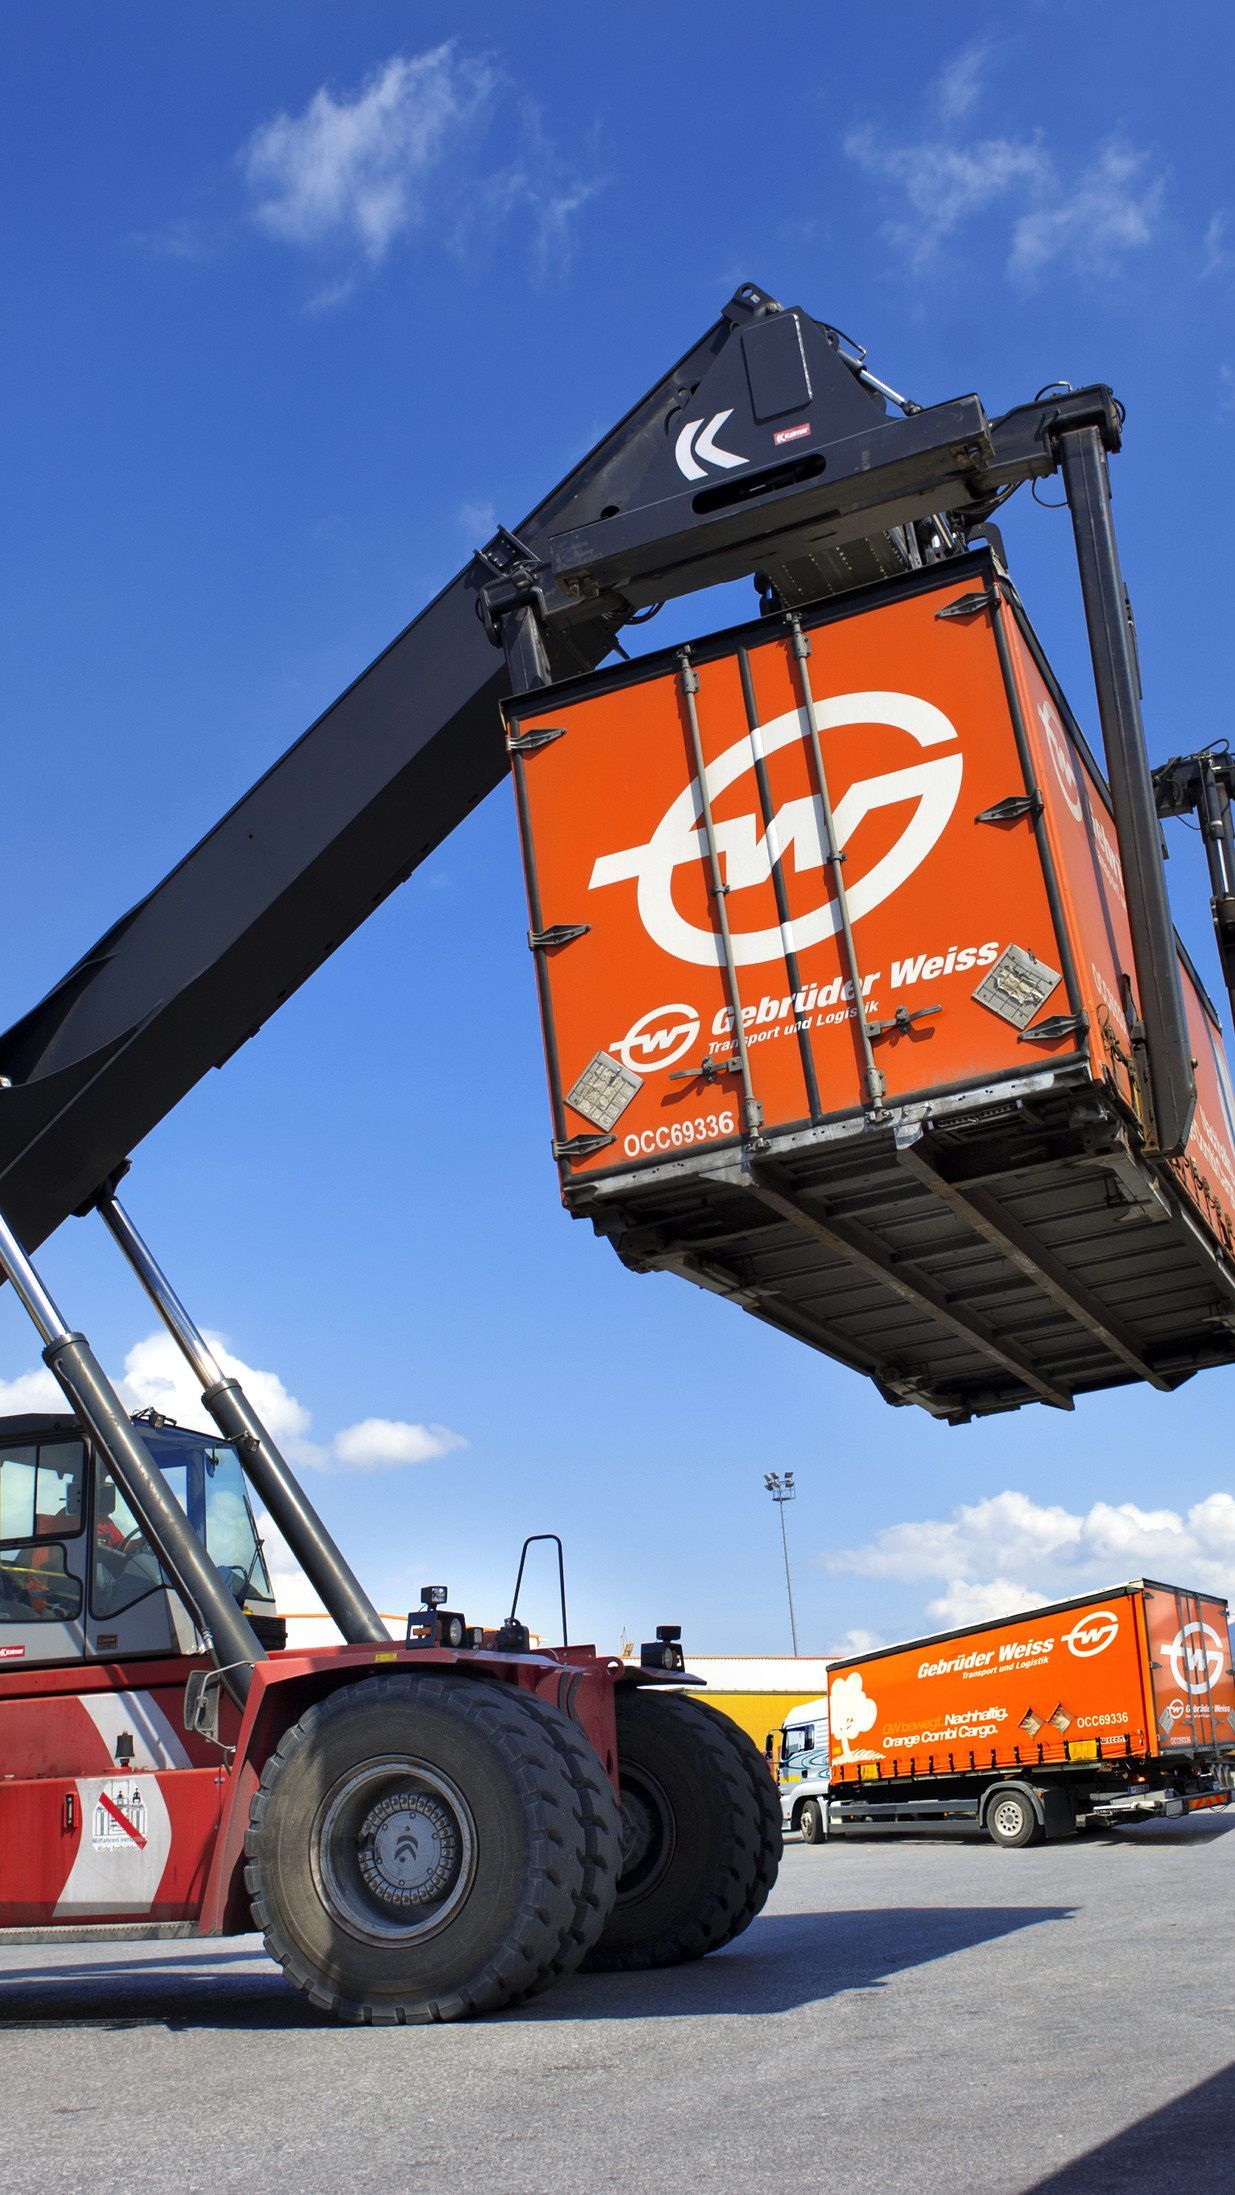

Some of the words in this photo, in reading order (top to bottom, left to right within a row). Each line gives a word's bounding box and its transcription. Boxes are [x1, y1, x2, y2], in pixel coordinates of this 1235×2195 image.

[711, 971, 881, 1036] Gebrüder
[890, 941, 1000, 989] Weiss
[783, 1016, 813, 1035] und
[816, 1000, 880, 1027] Logisik
[623, 1110, 734, 1157] OCC69336
[917, 1651, 995, 1679] Gebrüder
[998, 1636, 1055, 1662] Weiss
[962, 1666, 997, 1680] Transport
[999, 1663, 1015, 1673] und
[1015, 1656, 1050, 1669] Logistik
[944, 1706, 1008, 1727] Nachhaltig.
[1076, 1712, 1128, 1728] OCC69336
[882, 1735, 920, 1748] Orange
[920, 1726, 957, 1743] Combi
[958, 1724, 998, 1739] Cargo.
